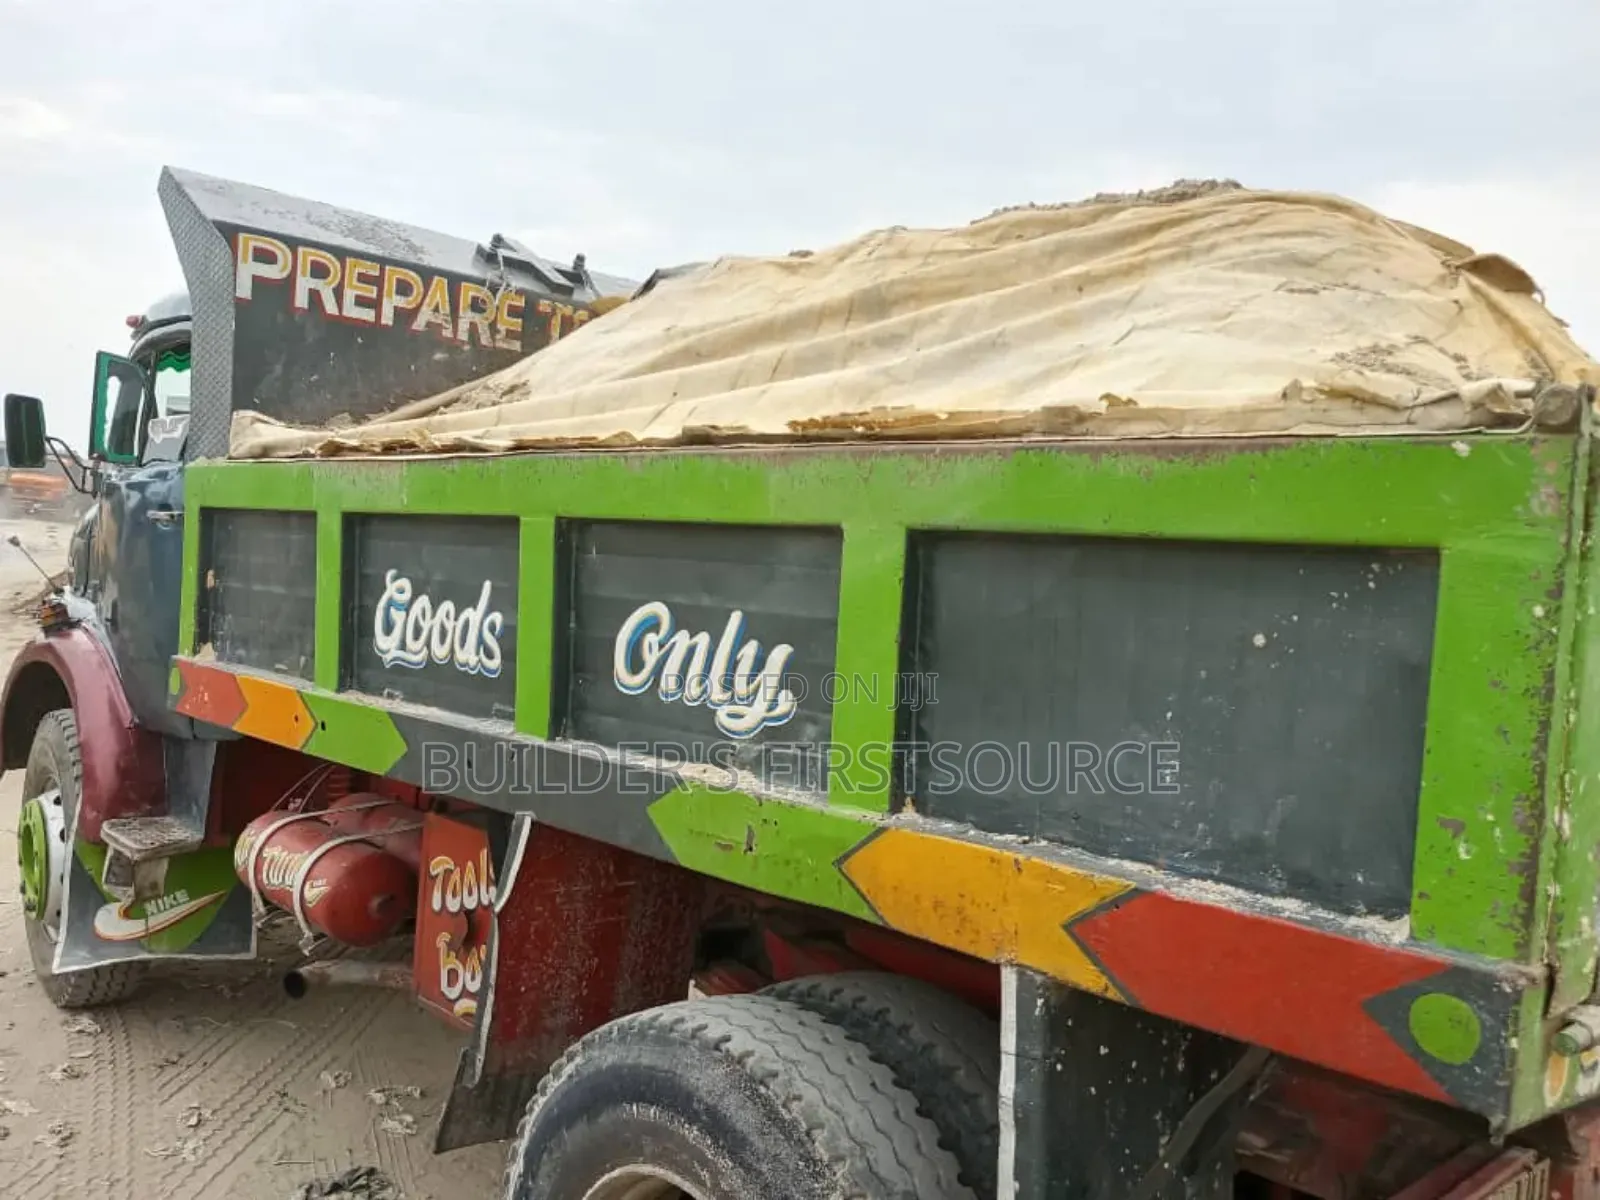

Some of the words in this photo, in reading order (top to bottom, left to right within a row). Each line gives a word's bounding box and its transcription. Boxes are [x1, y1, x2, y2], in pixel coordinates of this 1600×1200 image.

[233, 232, 526, 353] PREPARE
[373, 568, 504, 679] Goods
[613, 601, 797, 740] Only
[144, 888, 190, 916] NIKE
[436, 931, 487, 1000] bo
